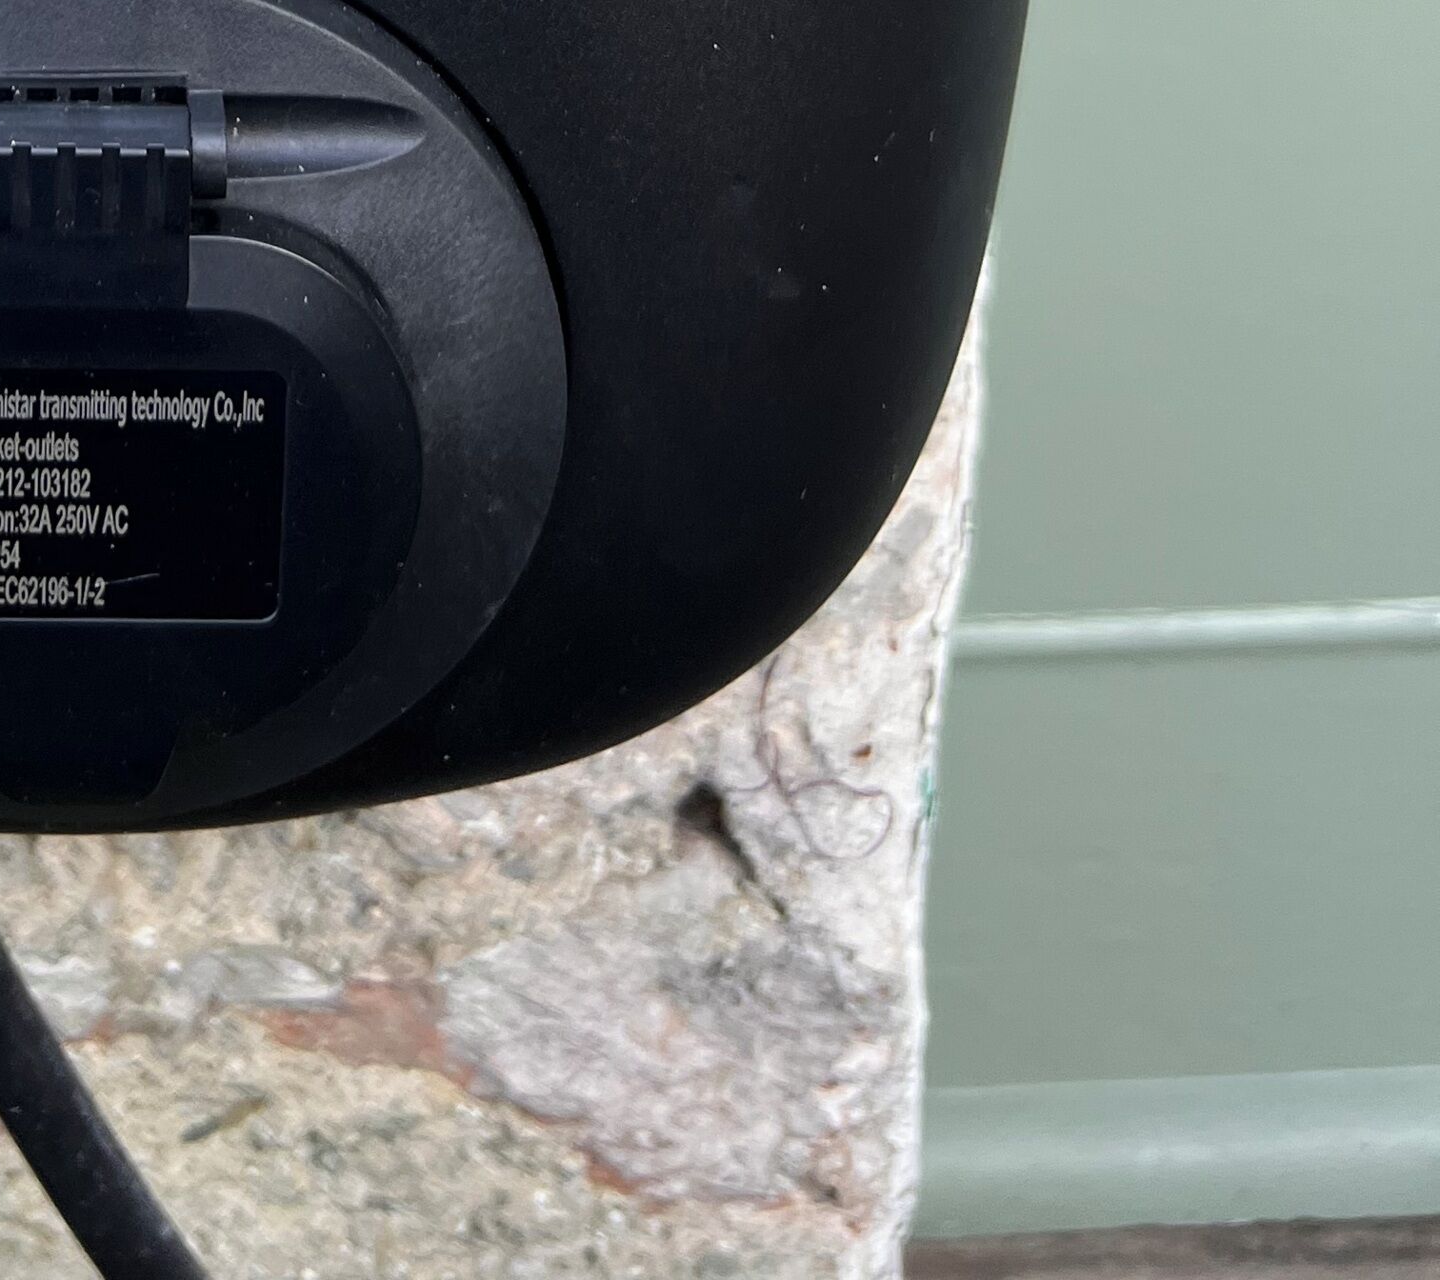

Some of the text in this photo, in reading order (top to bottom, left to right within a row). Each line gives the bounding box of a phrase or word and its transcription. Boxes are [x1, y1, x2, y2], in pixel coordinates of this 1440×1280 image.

[39, 389, 127, 427] transmitting
[131, 390, 210, 428] technology
[213, 390, 265, 428] Co.,Inc
[55, 506, 100, 534] 250V
[102, 505, 129, 535] AC
